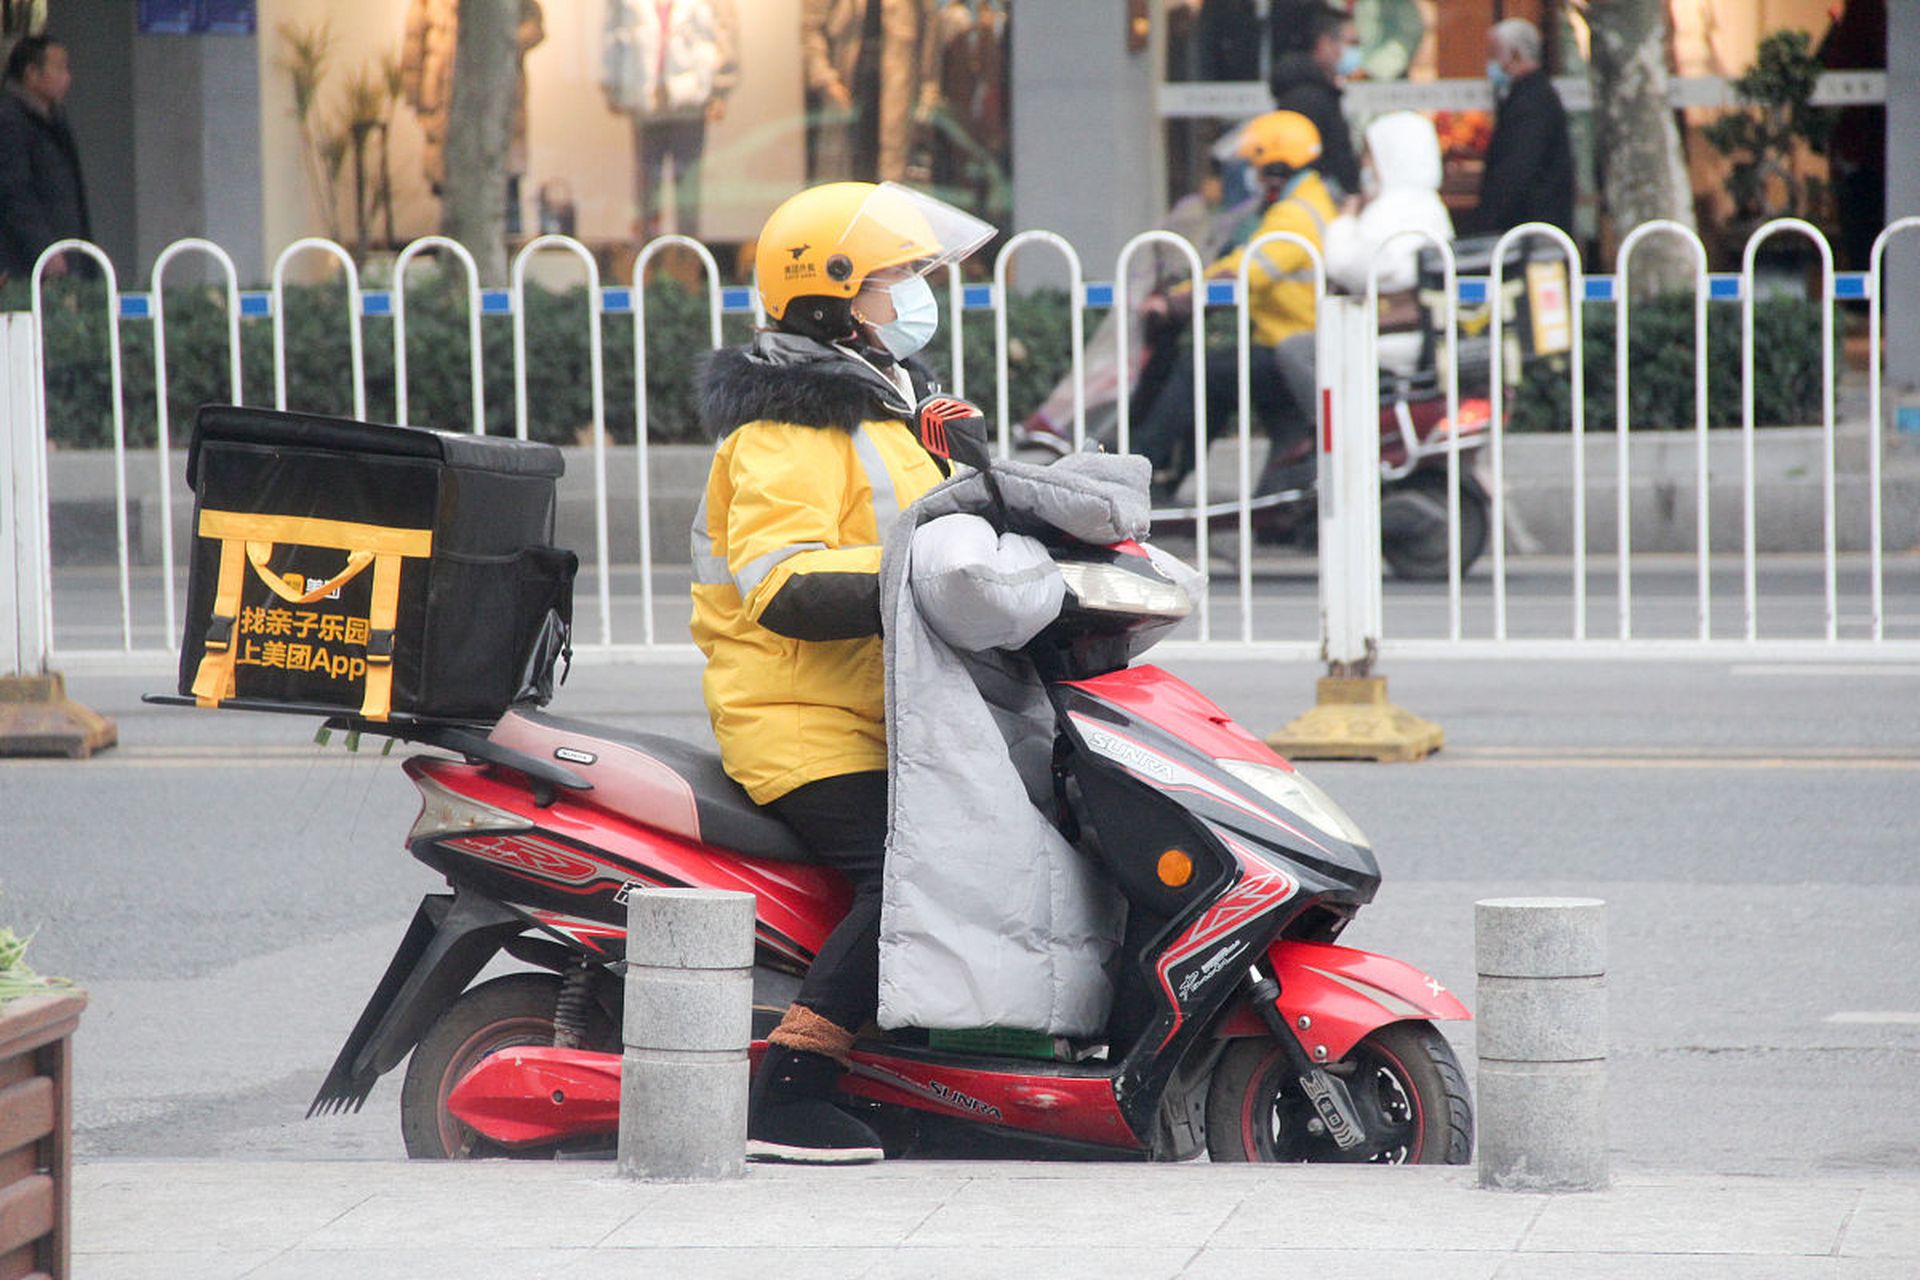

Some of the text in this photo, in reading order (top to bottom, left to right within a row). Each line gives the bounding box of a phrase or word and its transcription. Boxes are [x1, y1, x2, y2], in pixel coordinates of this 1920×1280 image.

[240, 606, 370, 646] 找亲子乐园
[236, 639, 367, 681] 上美团App
[1088, 732, 1174, 781] SUNRA
[929, 1080, 1003, 1120] SUNRA
